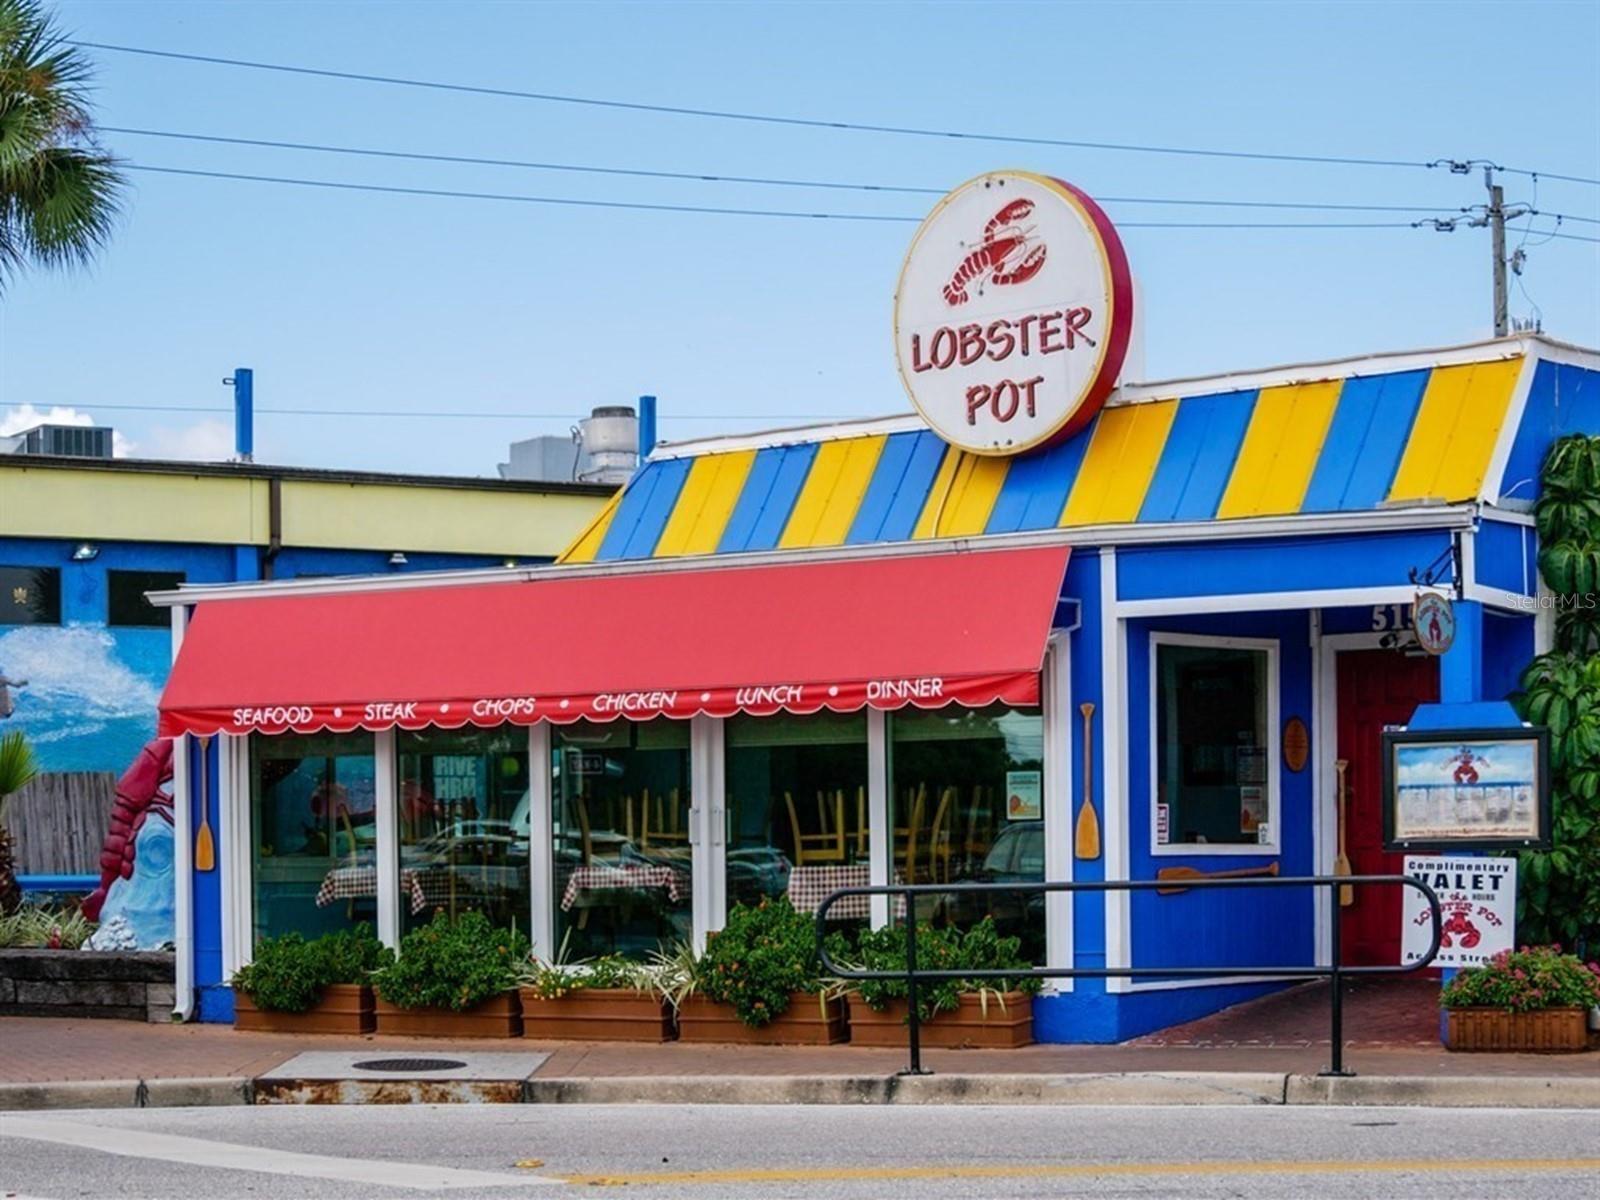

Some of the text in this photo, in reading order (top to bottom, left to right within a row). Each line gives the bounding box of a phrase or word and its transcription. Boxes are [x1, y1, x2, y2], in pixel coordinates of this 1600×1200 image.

[911, 307, 1096, 373] LOBSTER
[965, 376, 1044, 426] POT
[233, 678, 943, 726] SEAFOOD STEAK CHOPS CHICKEN LUNCH DINNER
[1408, 861, 1510, 873] Complimentary
[1413, 872, 1504, 891] VALET
[1413, 902, 1502, 928] LOSTER POT
[1406, 952, 1454, 961] Acss
